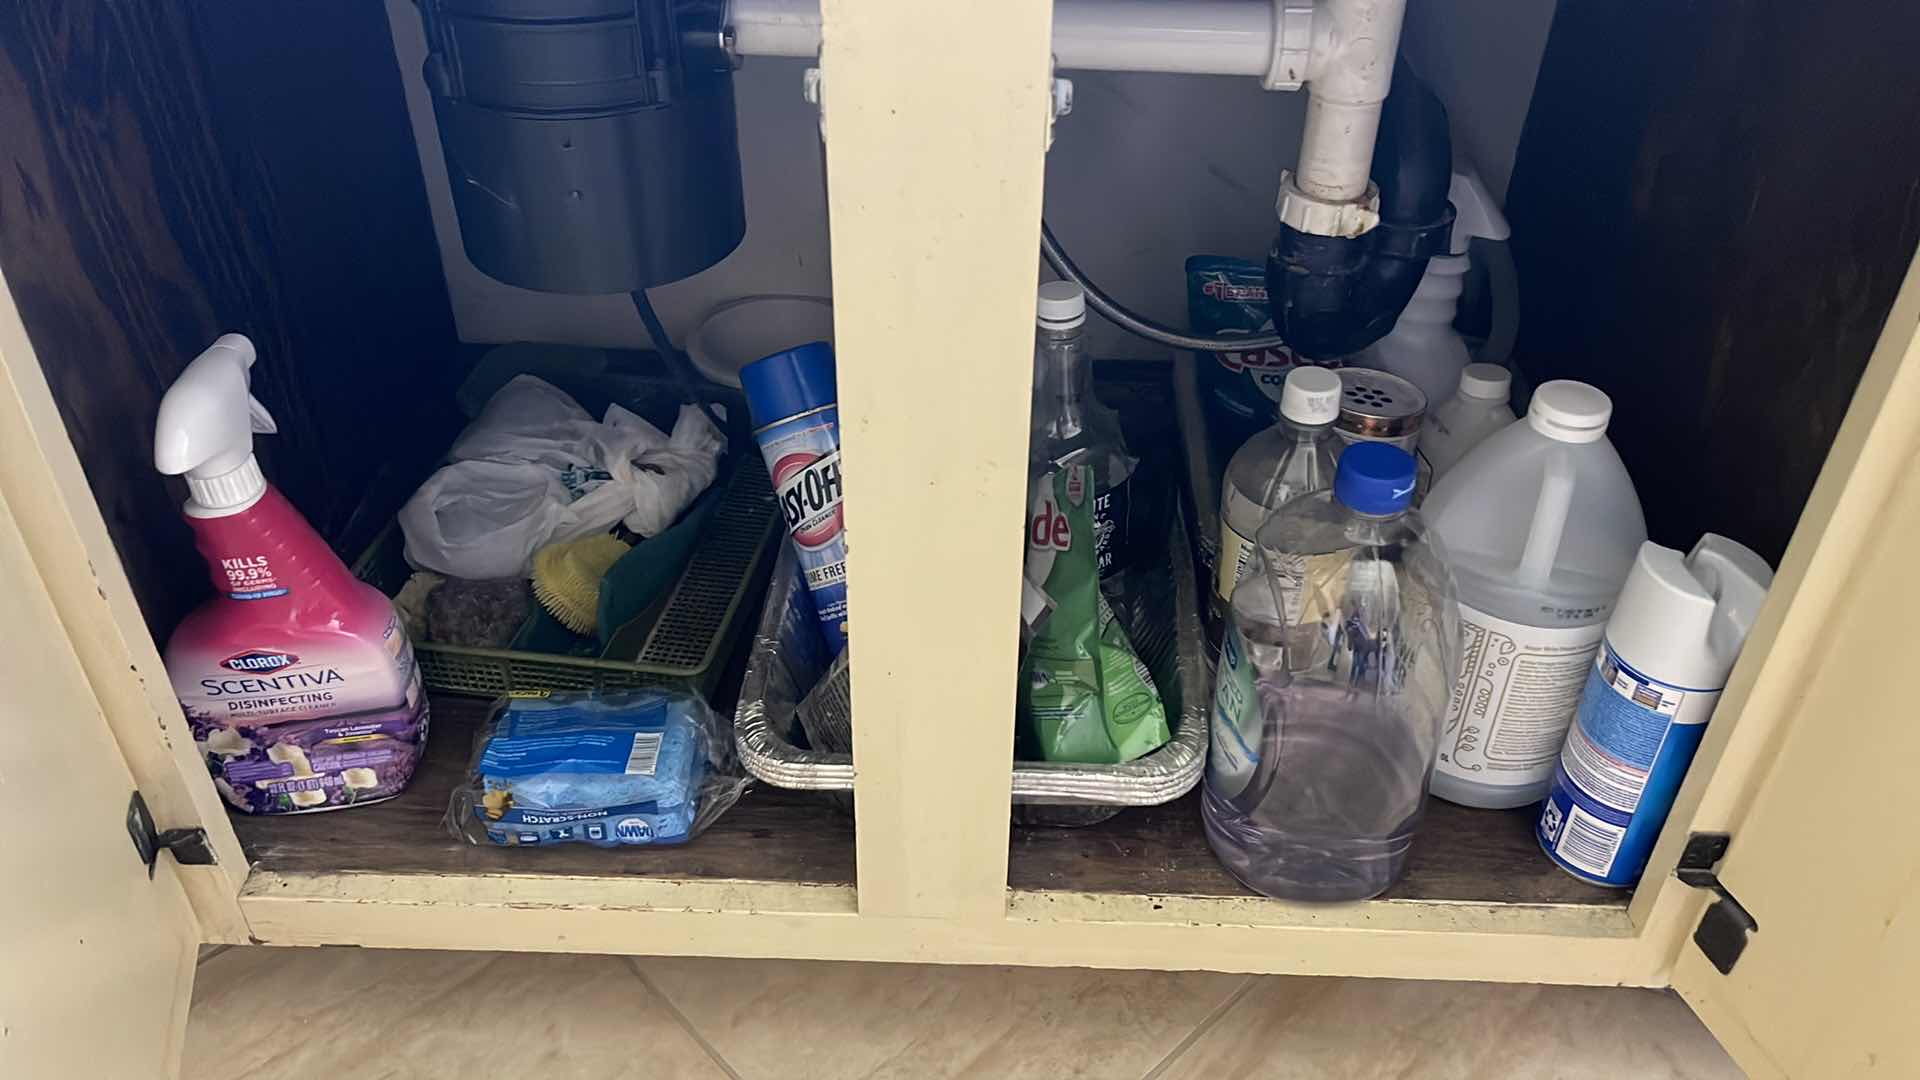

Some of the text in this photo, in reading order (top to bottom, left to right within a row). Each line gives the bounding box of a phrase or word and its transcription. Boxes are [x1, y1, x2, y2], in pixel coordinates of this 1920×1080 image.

[221, 556, 268, 569] KILLS
[226, 567, 272, 581] 99.9%
[229, 655, 291, 670] CLOROX
[200, 669, 345, 696] SCENTIVA
[228, 692, 333, 711] DISINFECTING
[522, 810, 608, 824] NON-SCRATCH
[616, 824, 657, 839] DAWN
